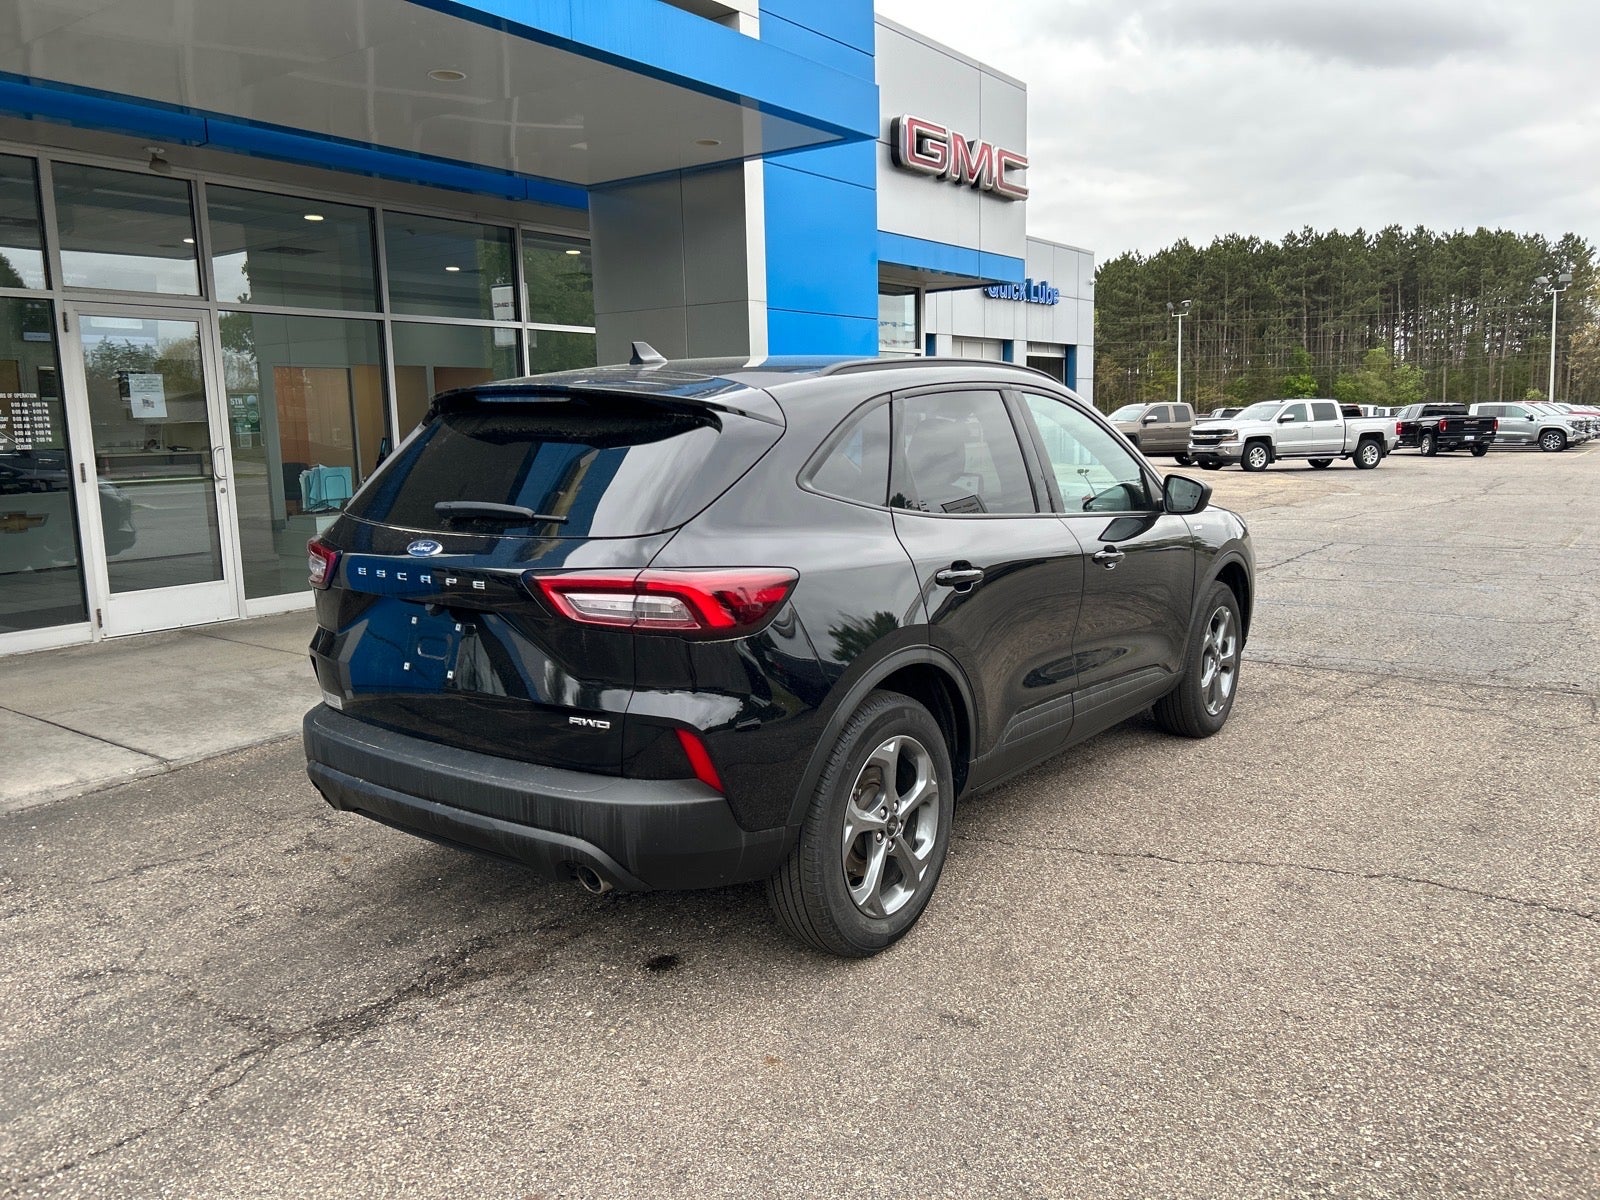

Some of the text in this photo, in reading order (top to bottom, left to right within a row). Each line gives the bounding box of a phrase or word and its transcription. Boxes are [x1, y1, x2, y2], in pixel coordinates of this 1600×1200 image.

[899, 114, 1029, 201] GMC
[987, 279, 1060, 305] Quick Lube
[410, 542, 434, 552] Ford
[357, 566, 486, 590] ESCAPE
[568, 716, 611, 729] AWD
